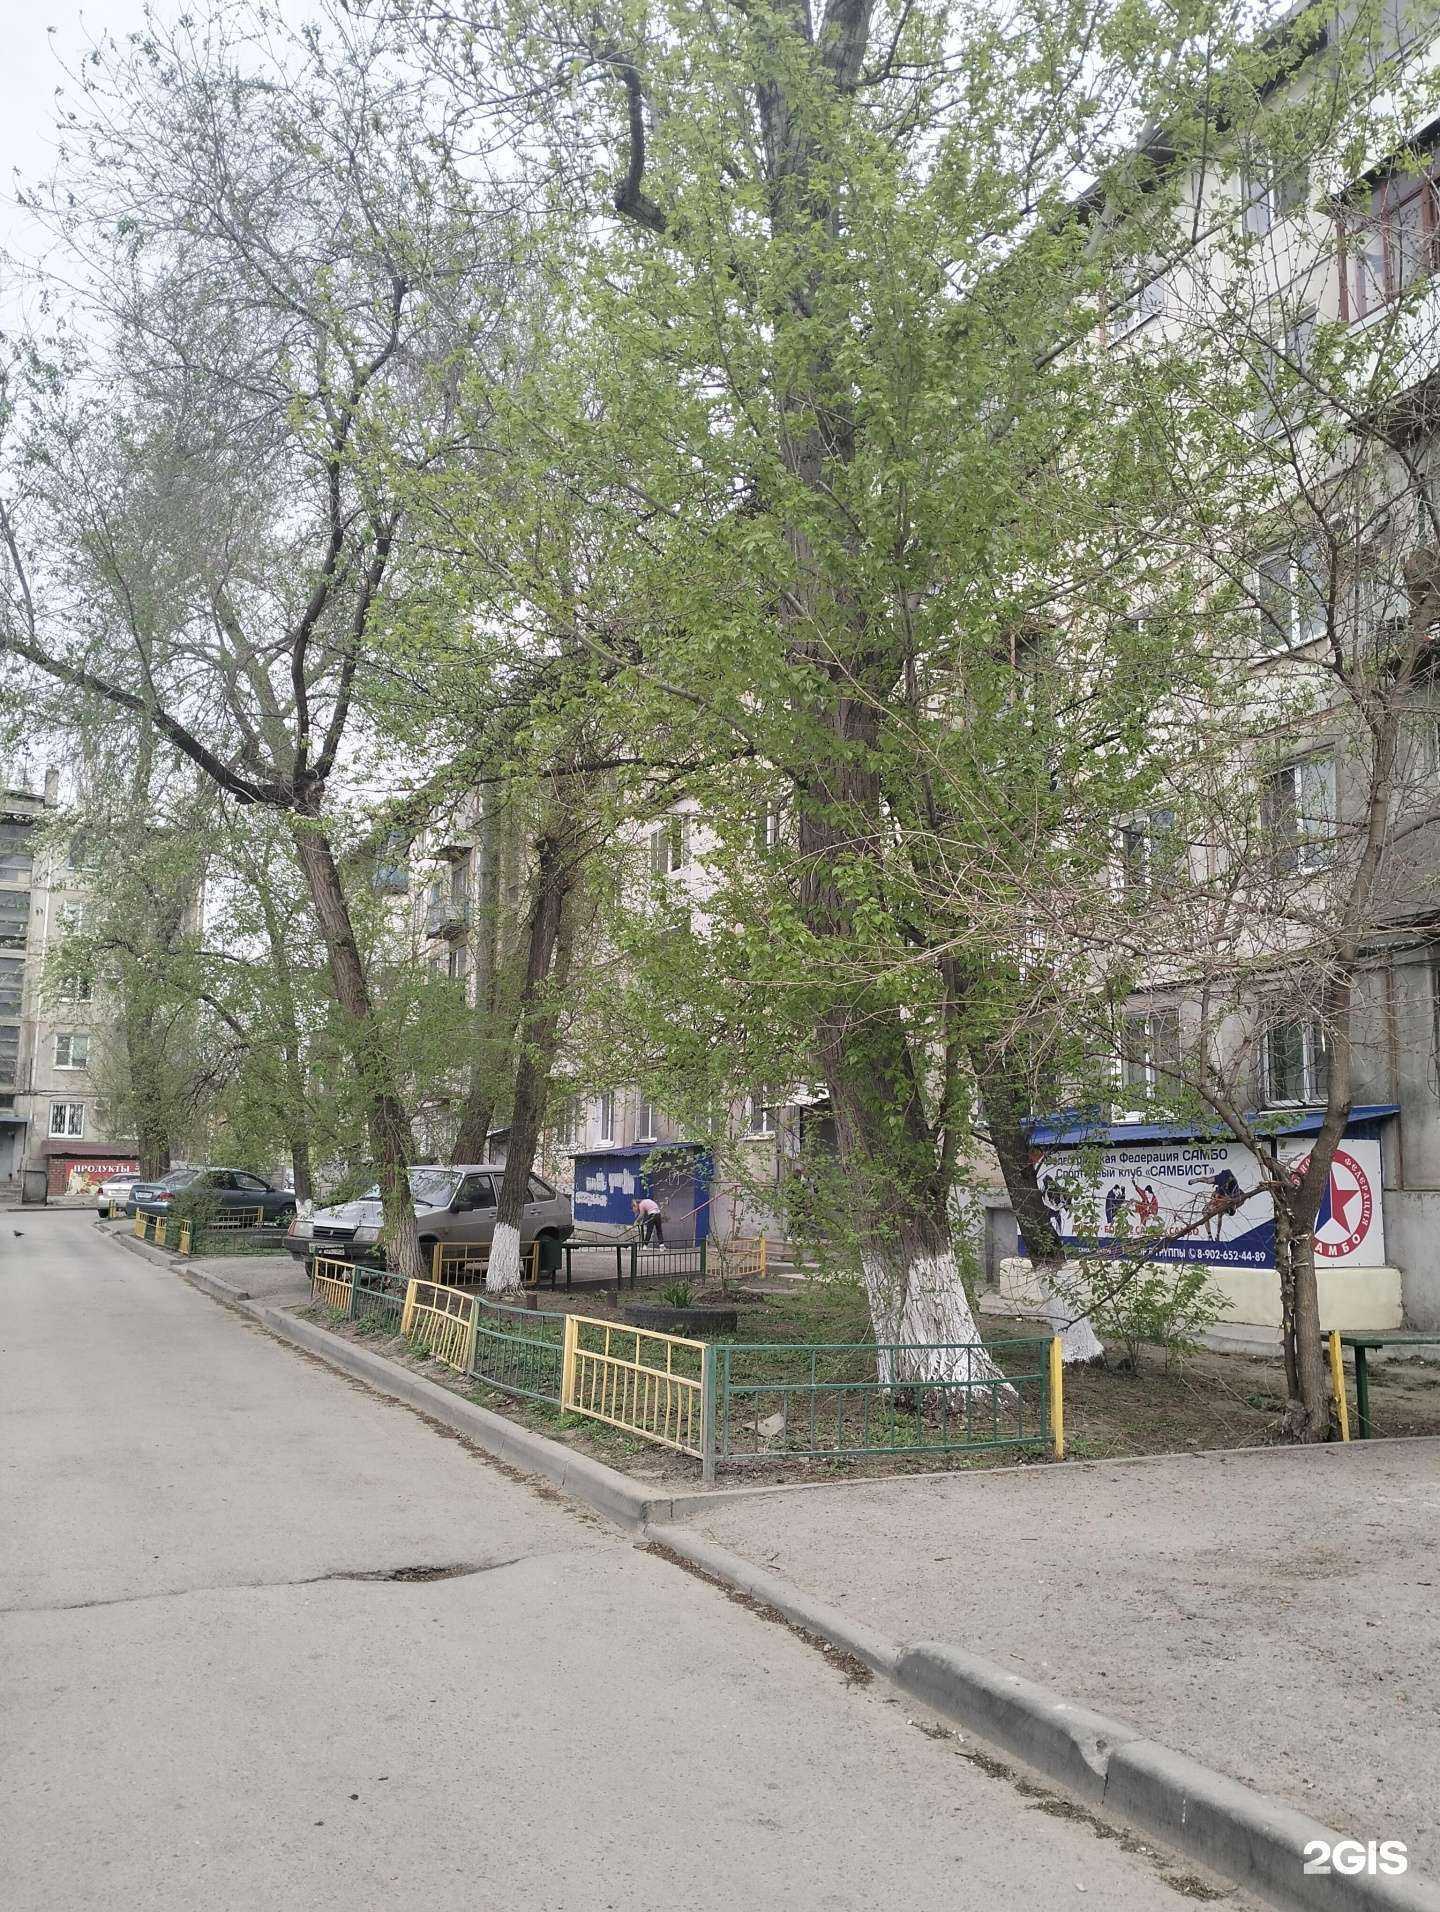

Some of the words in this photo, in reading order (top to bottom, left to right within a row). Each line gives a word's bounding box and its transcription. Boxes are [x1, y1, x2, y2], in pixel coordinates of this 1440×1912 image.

[1120, 1152, 1178, 1164] Федерация
[1182, 1148, 1228, 1160] САМБО
[73, 1163, 130, 1173] ПРОДУКТЫ
[1119, 1167, 1142, 1178] клуб
[1145, 1164, 1215, 1177] «САМБИСТ»
[1315, 1234, 1361, 1256] АМБО
[1197, 1249, 1266, 1262] 8-902-652-44-89
